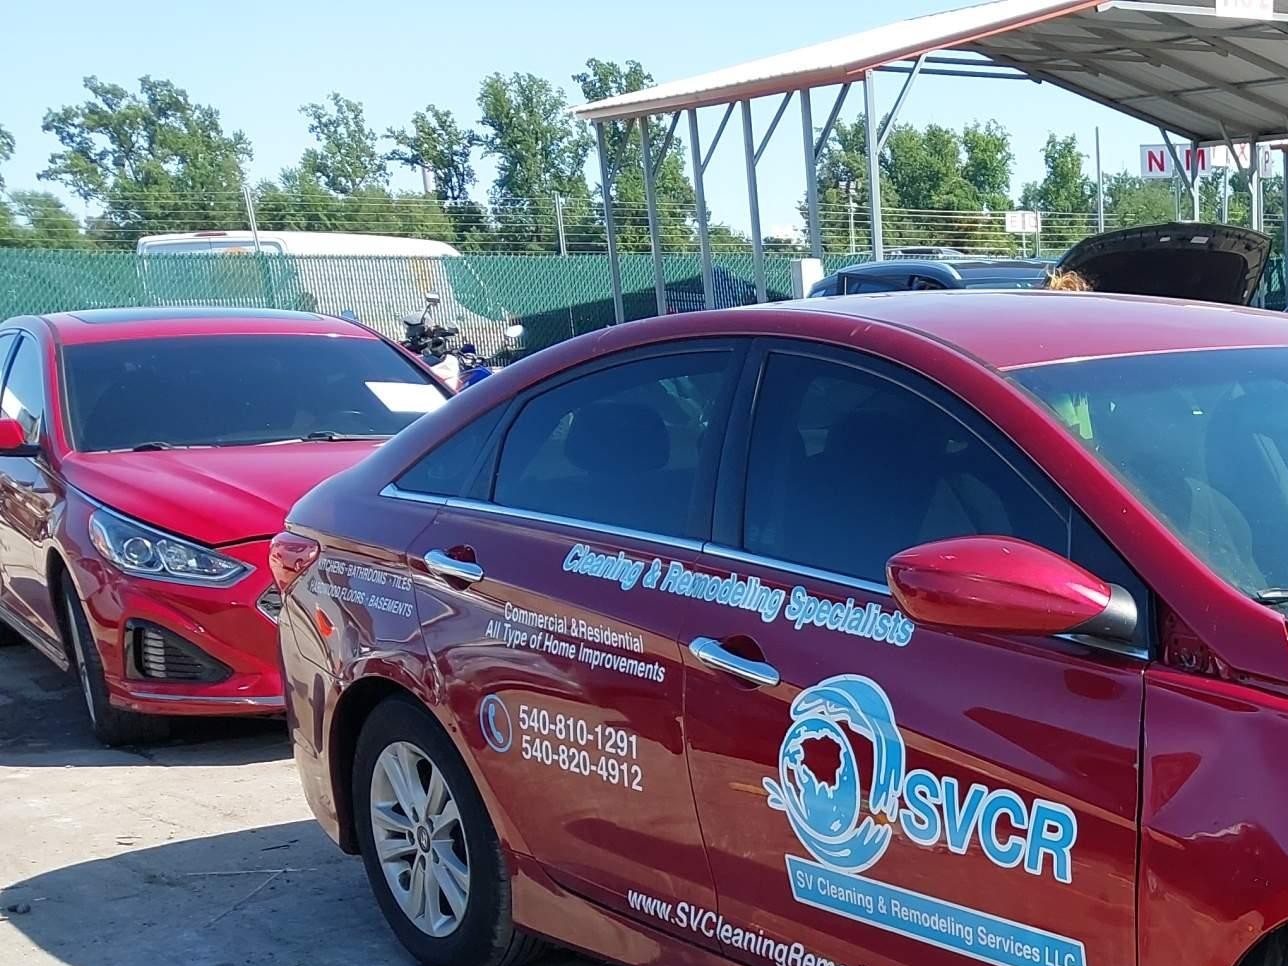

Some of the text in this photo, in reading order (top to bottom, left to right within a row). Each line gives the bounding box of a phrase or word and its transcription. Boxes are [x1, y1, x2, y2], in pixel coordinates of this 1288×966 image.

[1147, 150, 1165, 172] N
[1185, 149, 1206, 171] M
[340, 586, 366, 604] FLOORS
[368, 594, 414, 617] BASEMENTS
[347, 564, 388, 585] BATHROOMS
[391, 574, 413, 592] TILES
[562, 544, 915, 647] Cleaning & Remodeling Specialists
[504, 601, 567, 635] Commercial
[485, 619, 666, 683] All Type of Home Improvements
[518, 704, 638, 760] 540-810-1291
[521, 735, 644, 792] 540-820-4912
[899, 768, 1078, 884] SVCR
[796, 870, 814, 890] SV
[817, 876, 874, 914] Cleaning
[877, 895, 888, 914] &
[890, 899, 973, 945] Remodeling
[976, 926, 1041, 962] Services
